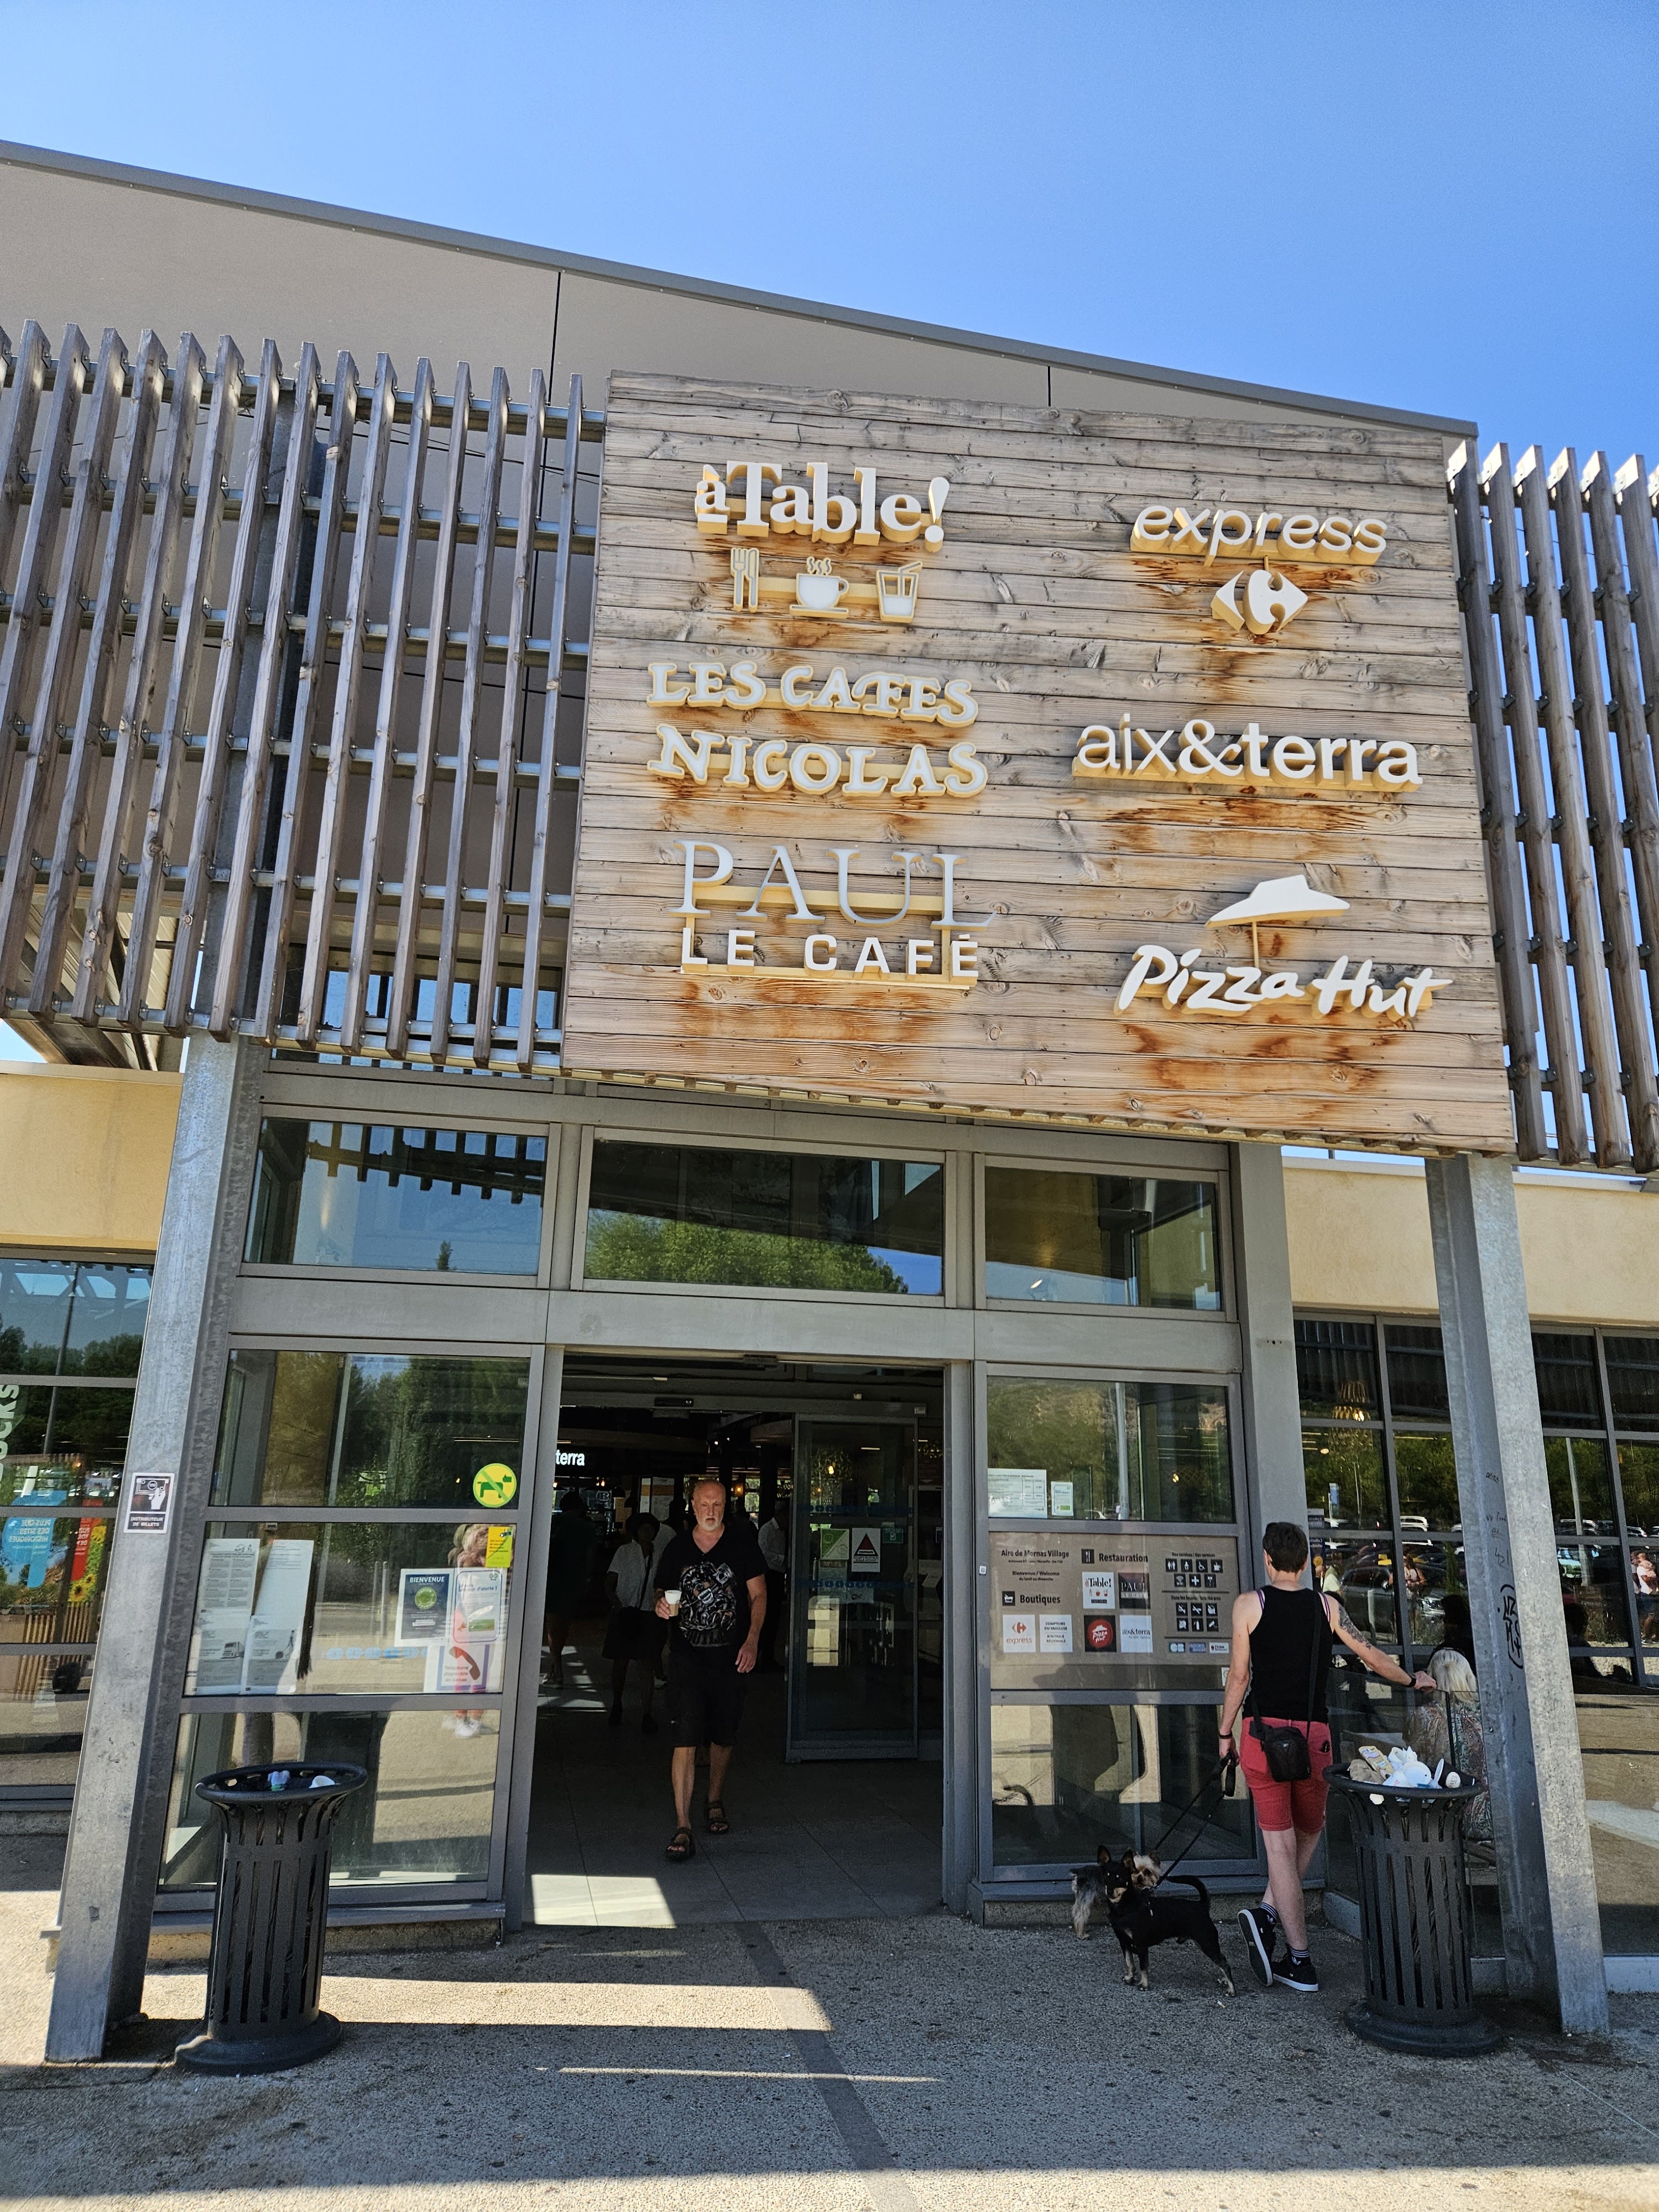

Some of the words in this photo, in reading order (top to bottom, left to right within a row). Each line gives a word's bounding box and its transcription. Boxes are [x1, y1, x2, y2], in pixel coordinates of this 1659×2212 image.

[1133, 505, 1387, 560] express
[647, 661, 766, 710] LES
[646, 723, 989, 797] NICOLAS
[1076, 713, 1423, 788] aix&terra
[670, 839, 995, 931] PAUL
[681, 926, 756, 973] LE
[804, 932, 979, 986] CAFÉ
[1115, 943, 1305, 1014] Pizza
[1311, 955, 1454, 1019] Hut
[556, 1449, 585, 1466] terra
[1048, 1550, 1070, 1559] Village
[1099, 1553, 1149, 1562] Restauration
[1020, 1594, 1061, 1606] Boutiques
